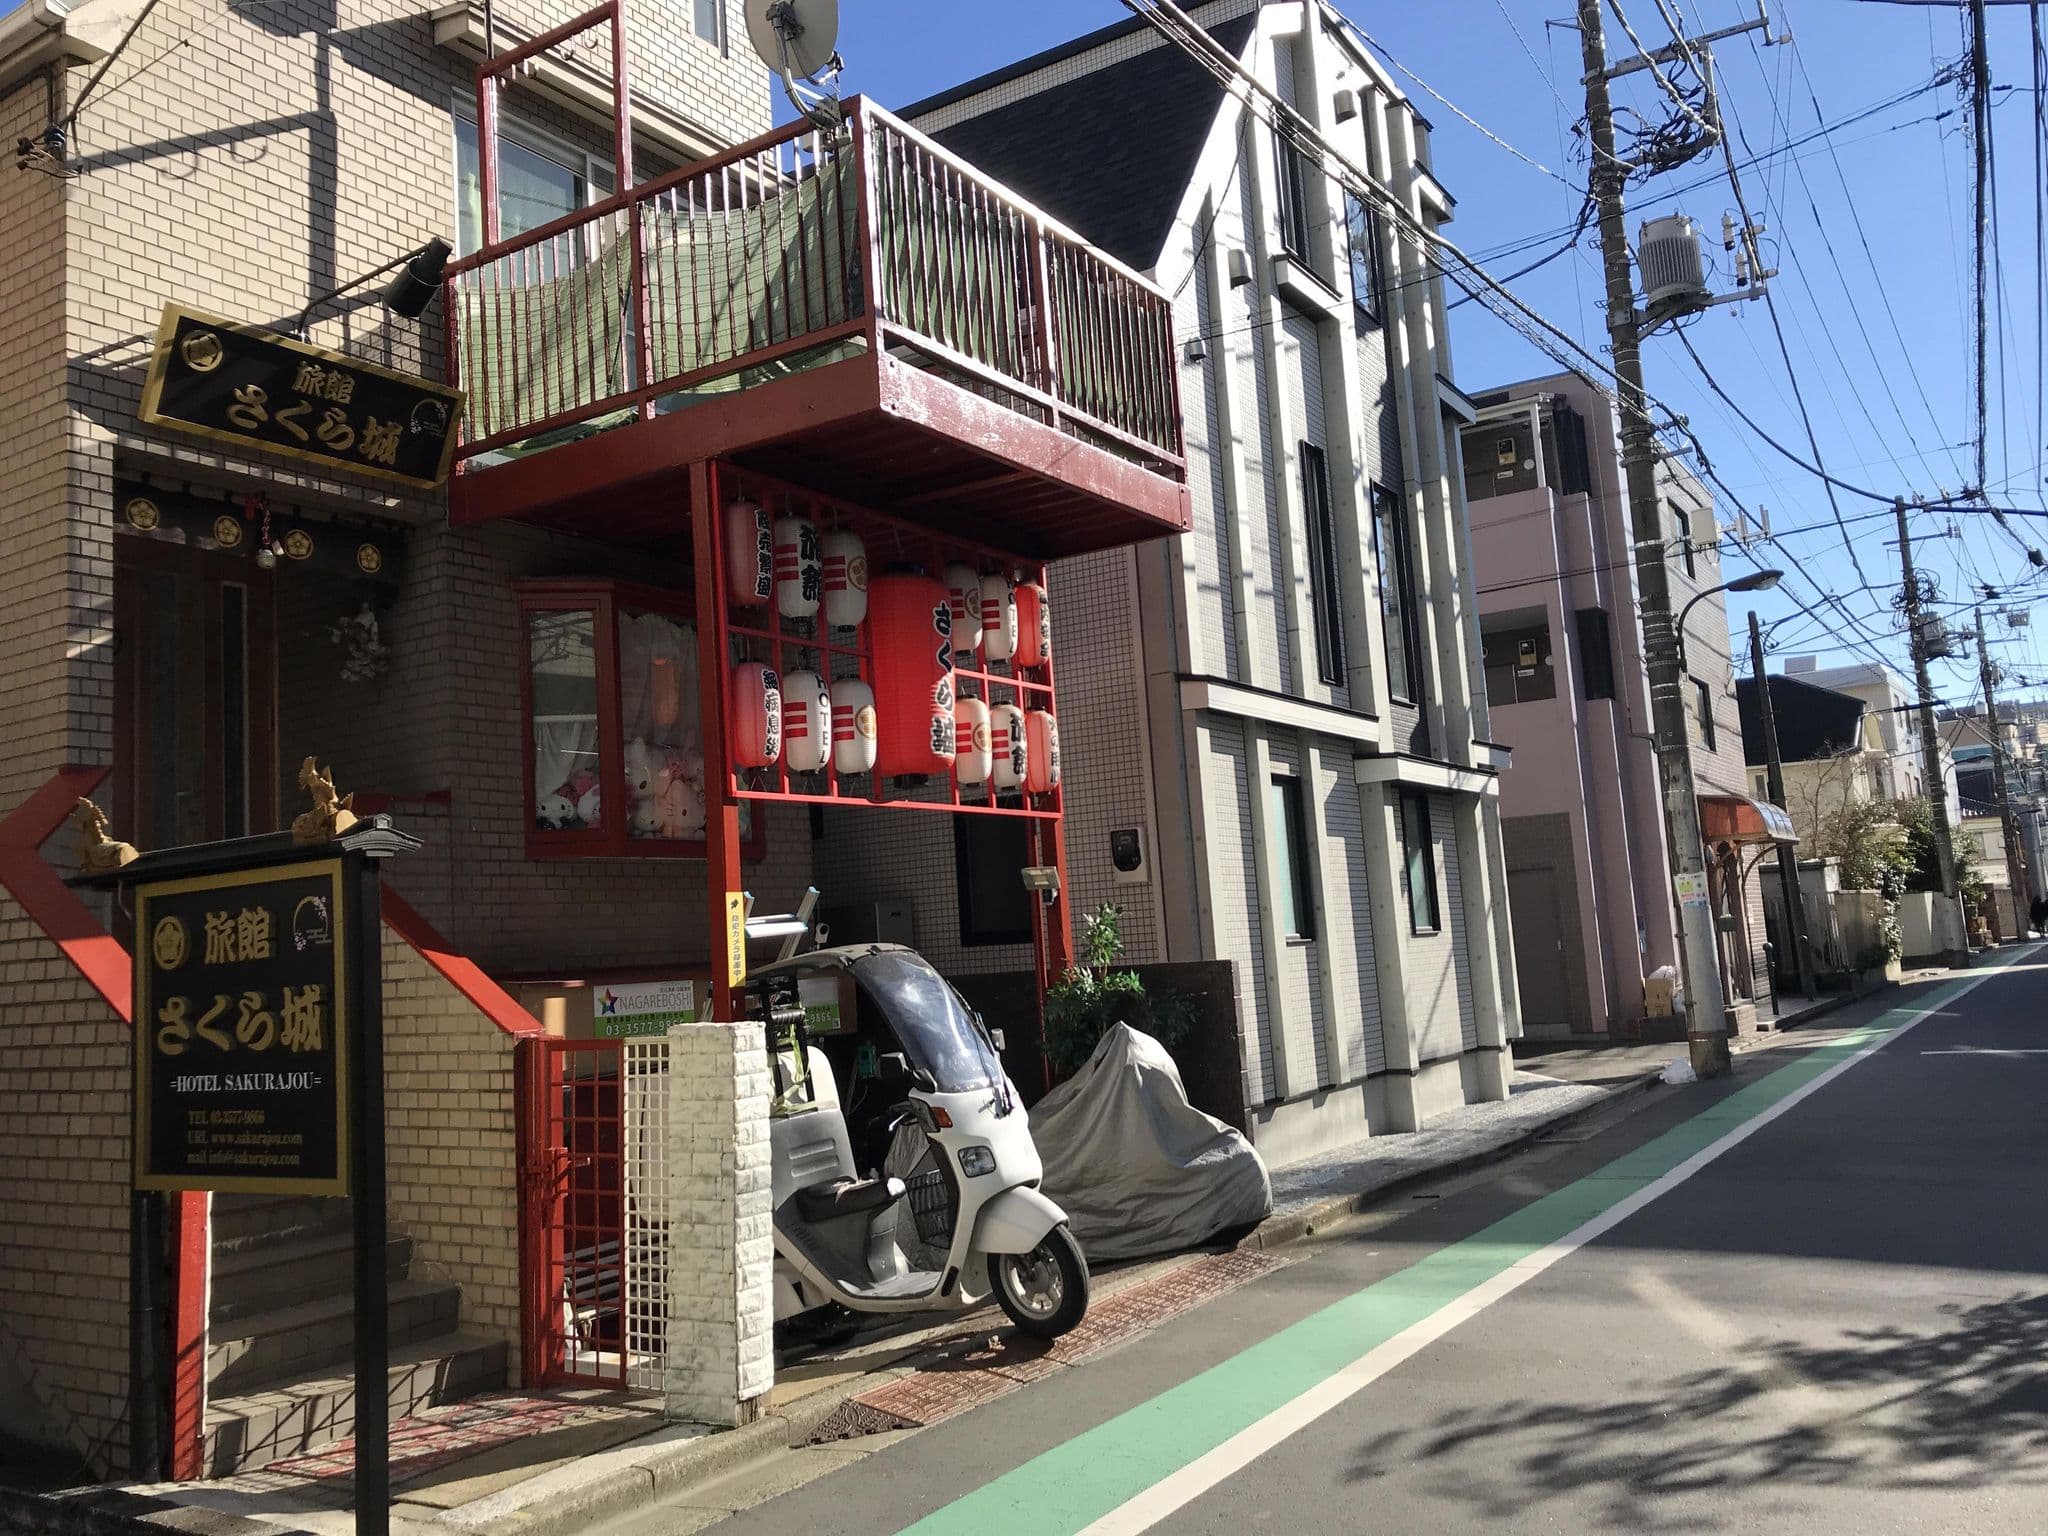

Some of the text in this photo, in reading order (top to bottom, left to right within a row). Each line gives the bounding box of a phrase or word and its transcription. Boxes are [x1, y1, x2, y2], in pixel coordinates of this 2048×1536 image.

[291, 360, 356, 405] 旅館
[227, 384, 404, 465] さくら城
[203, 907, 273, 965] 旅館
[156, 984, 328, 1056] さくら城
[619, 991, 692, 1012] NAGAREBOSHI
[606, 1018, 685, 1036] 03-3577-98
[187, 1109, 208, 1125] TEL
